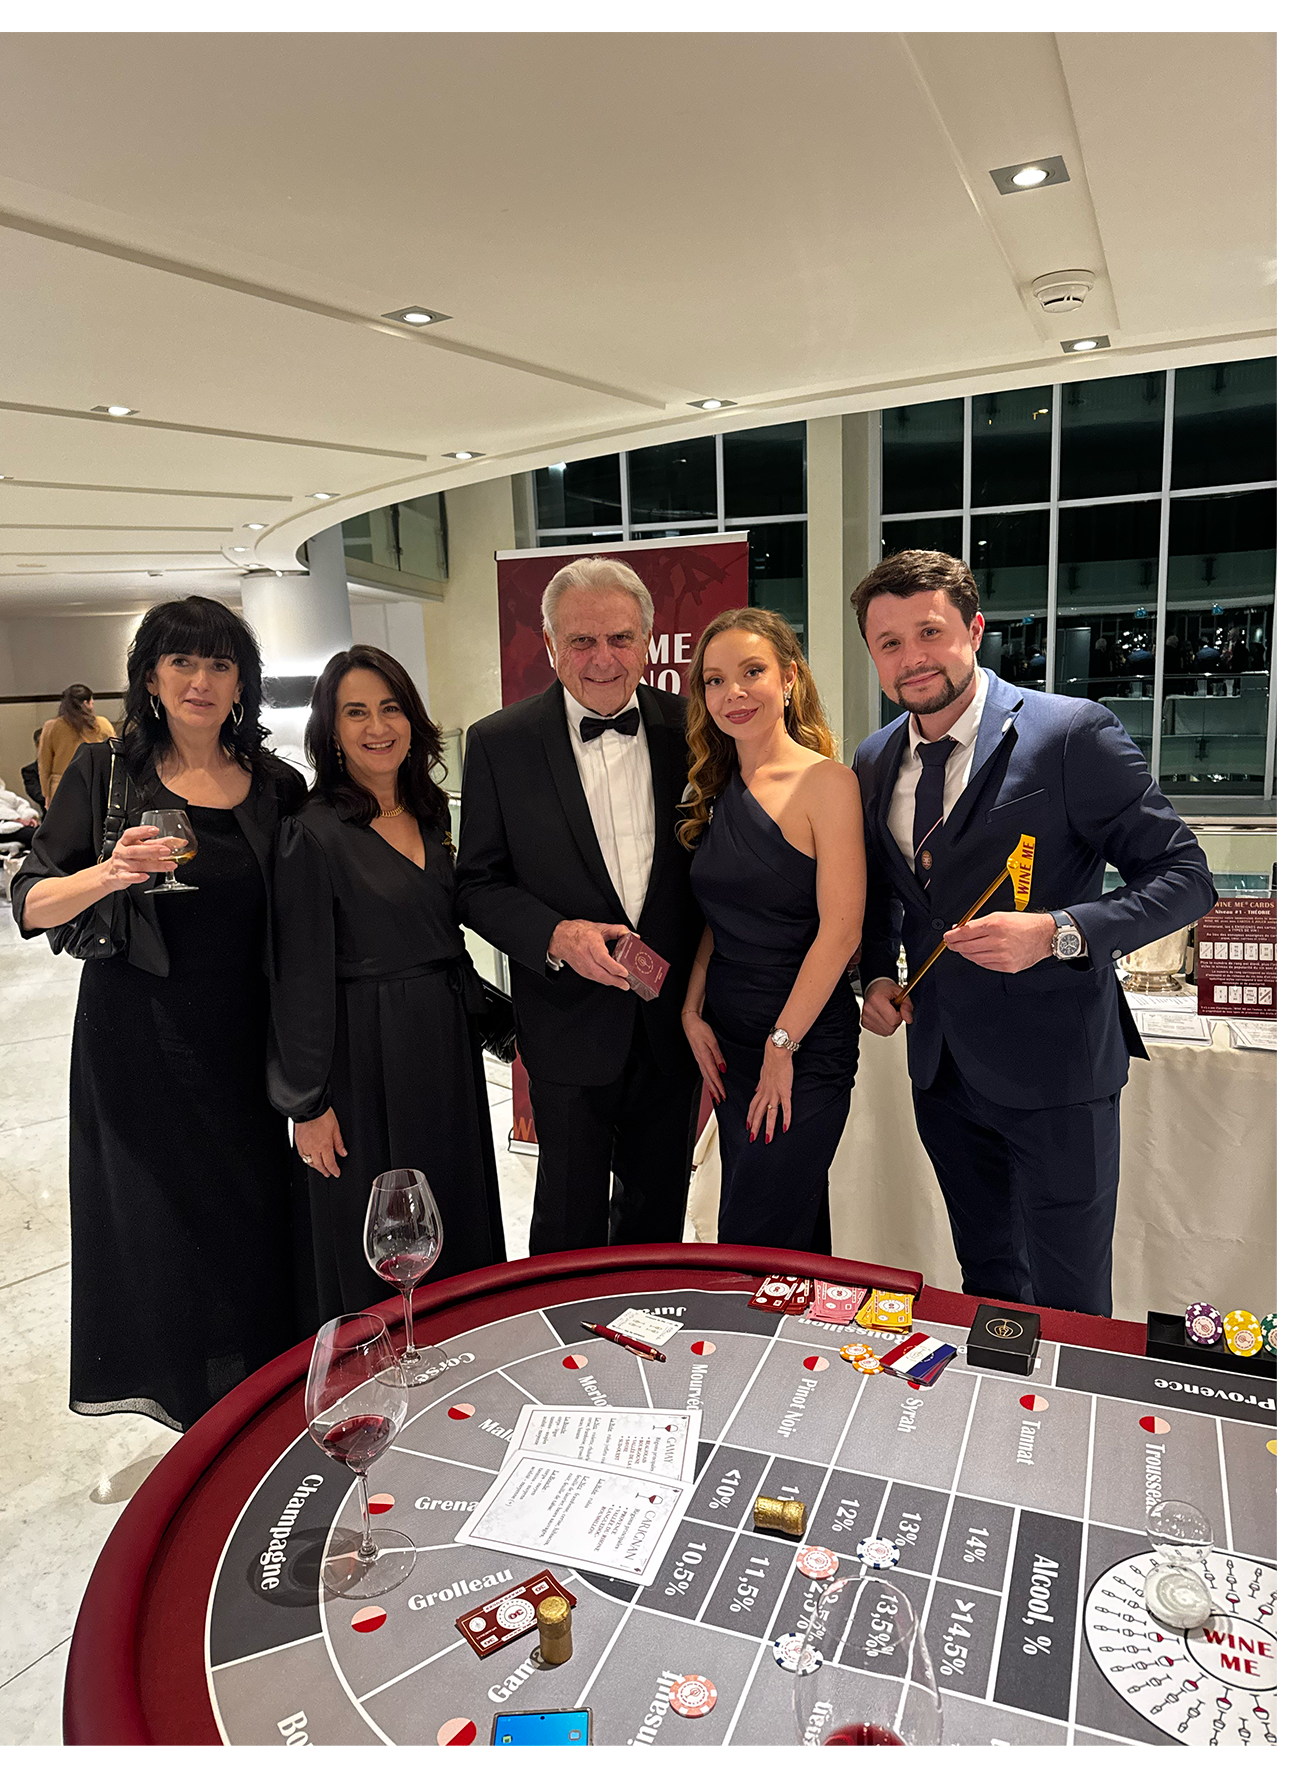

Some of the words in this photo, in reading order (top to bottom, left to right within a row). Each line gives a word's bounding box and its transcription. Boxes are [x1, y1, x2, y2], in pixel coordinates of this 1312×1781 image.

[645, 633, 692, 664] ME
[1022, 841, 1035, 861] ME
[1017, 863, 1032, 895] WINE
[414, 1352, 476, 1383] Corse
[687, 1364, 708, 1411] Mourvé
[792, 1378, 818, 1413] Pinot
[1154, 1378, 1277, 1411] Provence
[777, 1410, 804, 1438] Noir
[897, 1397, 924, 1434] Syrah
[662, 1436, 678, 1464] GAMAY
[1016, 1420, 1041, 1465] Tannat
[414, 1496, 480, 1512] Grena
[709, 1468, 742, 1509] <10%
[259, 1473, 324, 1591] Champagne
[831, 1498, 860, 1532] 12%
[894, 1511, 922, 1547] 13%
[622, 1509, 658, 1561] CARIGNAN
[963, 1527, 990, 1563] 14%
[664, 1542, 707, 1597] 10,5%
[729, 1556, 770, 1613] 11,5%
[407, 1567, 514, 1611] Grolleau
[1021, 1553, 1060, 1625] Alcool,
[939, 1599, 976, 1677] >14,5%
[1022, 1635, 1052, 1656] %
[1202, 1627, 1275, 1659] WINE
[487, 1648, 545, 1703] Gama
[1220, 1653, 1261, 1677] ME
[627, 1669, 684, 1747] insault
